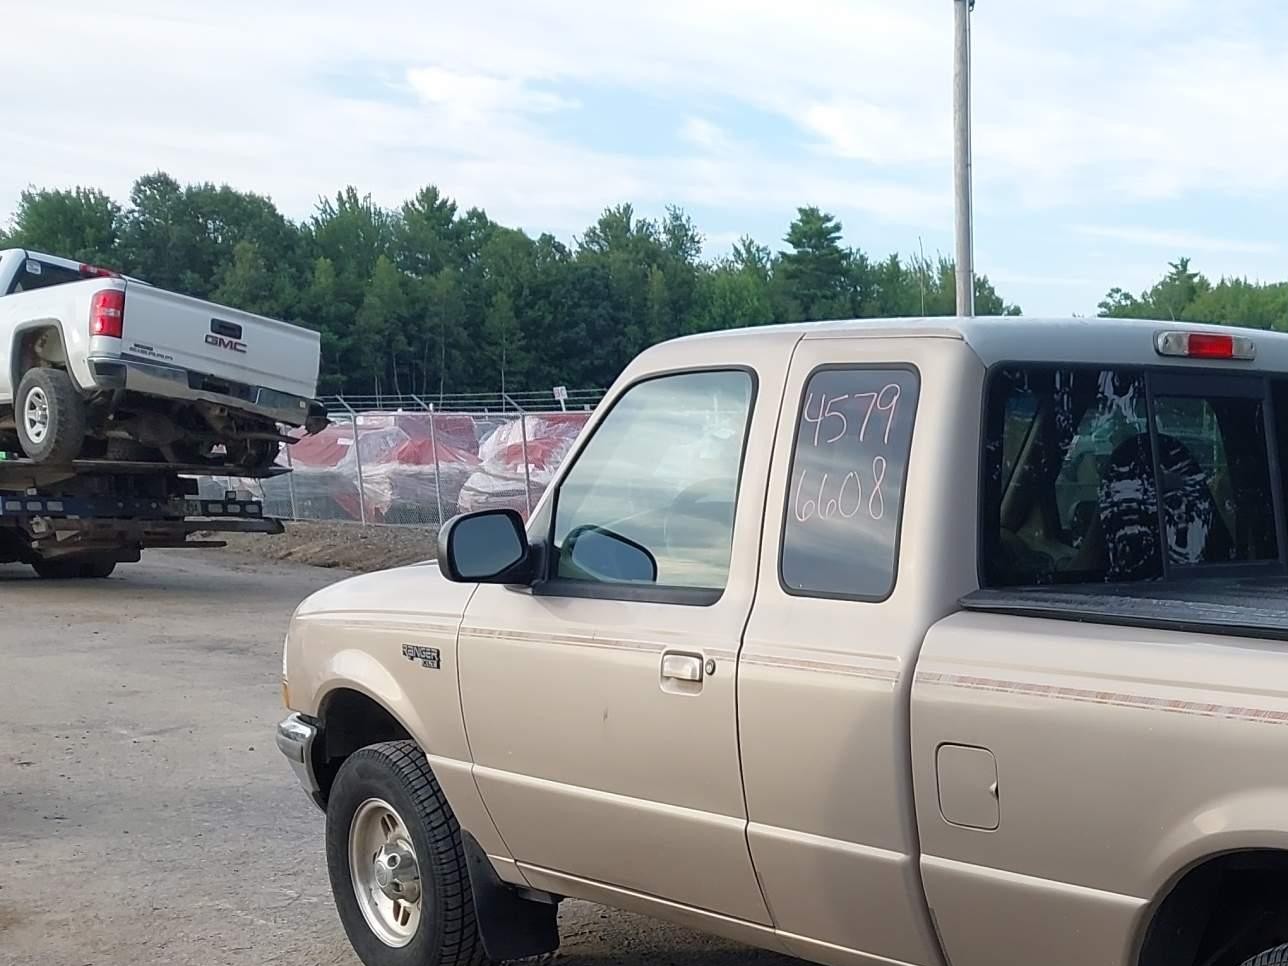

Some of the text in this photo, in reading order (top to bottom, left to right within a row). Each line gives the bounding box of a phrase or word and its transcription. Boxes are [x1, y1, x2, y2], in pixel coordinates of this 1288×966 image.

[205, 334, 247, 353] GMC
[804, 383, 901, 447] 4579
[795, 456, 887, 522] 6608
